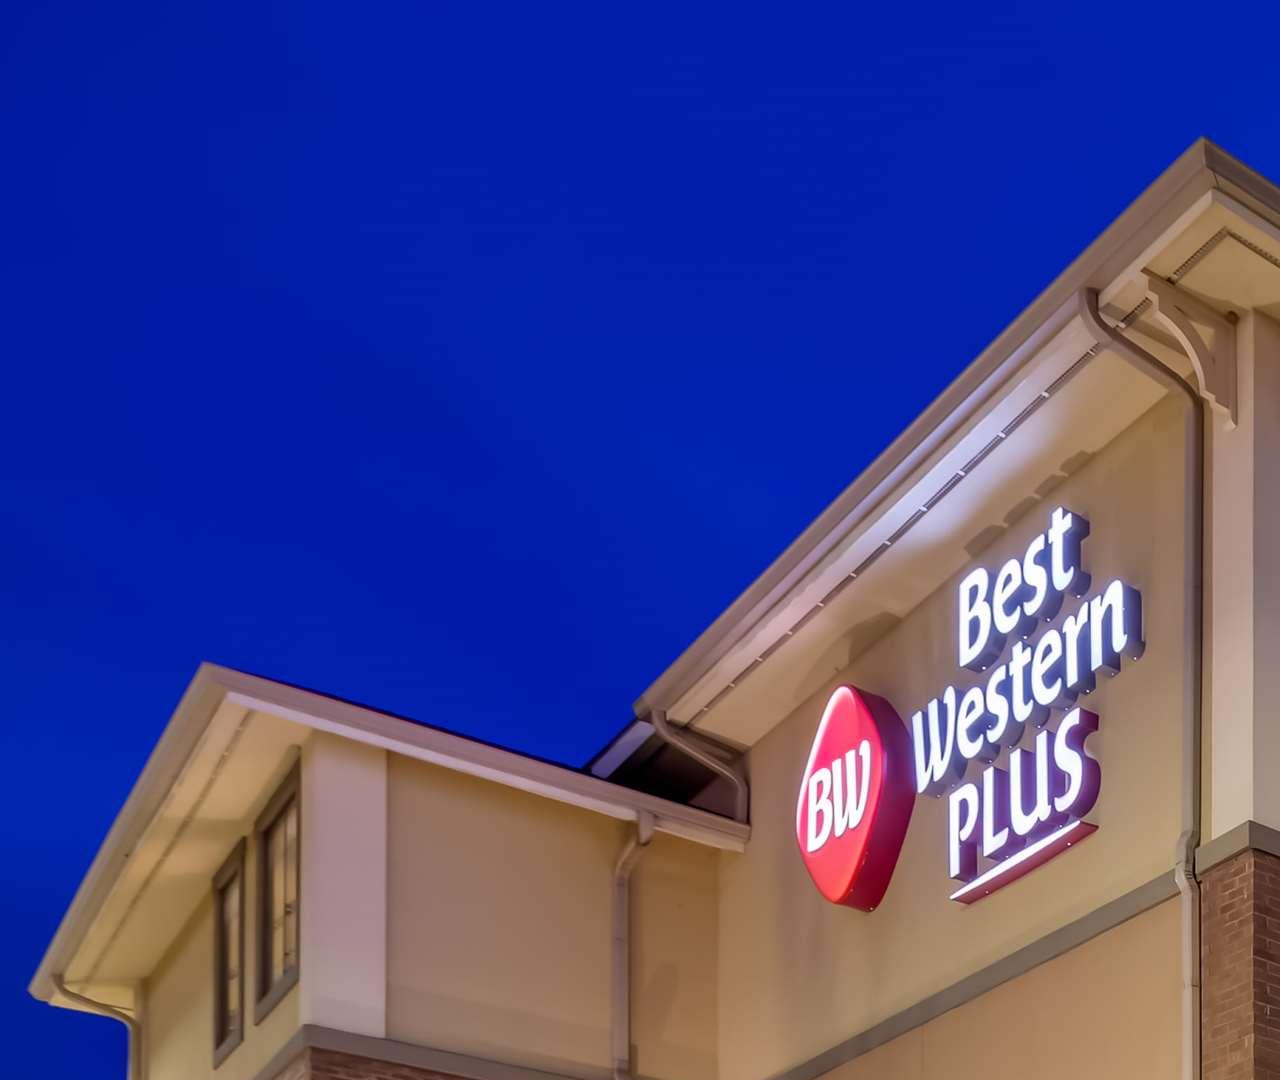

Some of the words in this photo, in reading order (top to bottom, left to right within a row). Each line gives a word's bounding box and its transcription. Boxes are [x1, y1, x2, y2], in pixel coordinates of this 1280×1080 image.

[958, 505, 1074, 668] Best
[911, 579, 1128, 794] Western
[806, 739, 871, 853] BW
[948, 706, 1083, 879] PLUS
